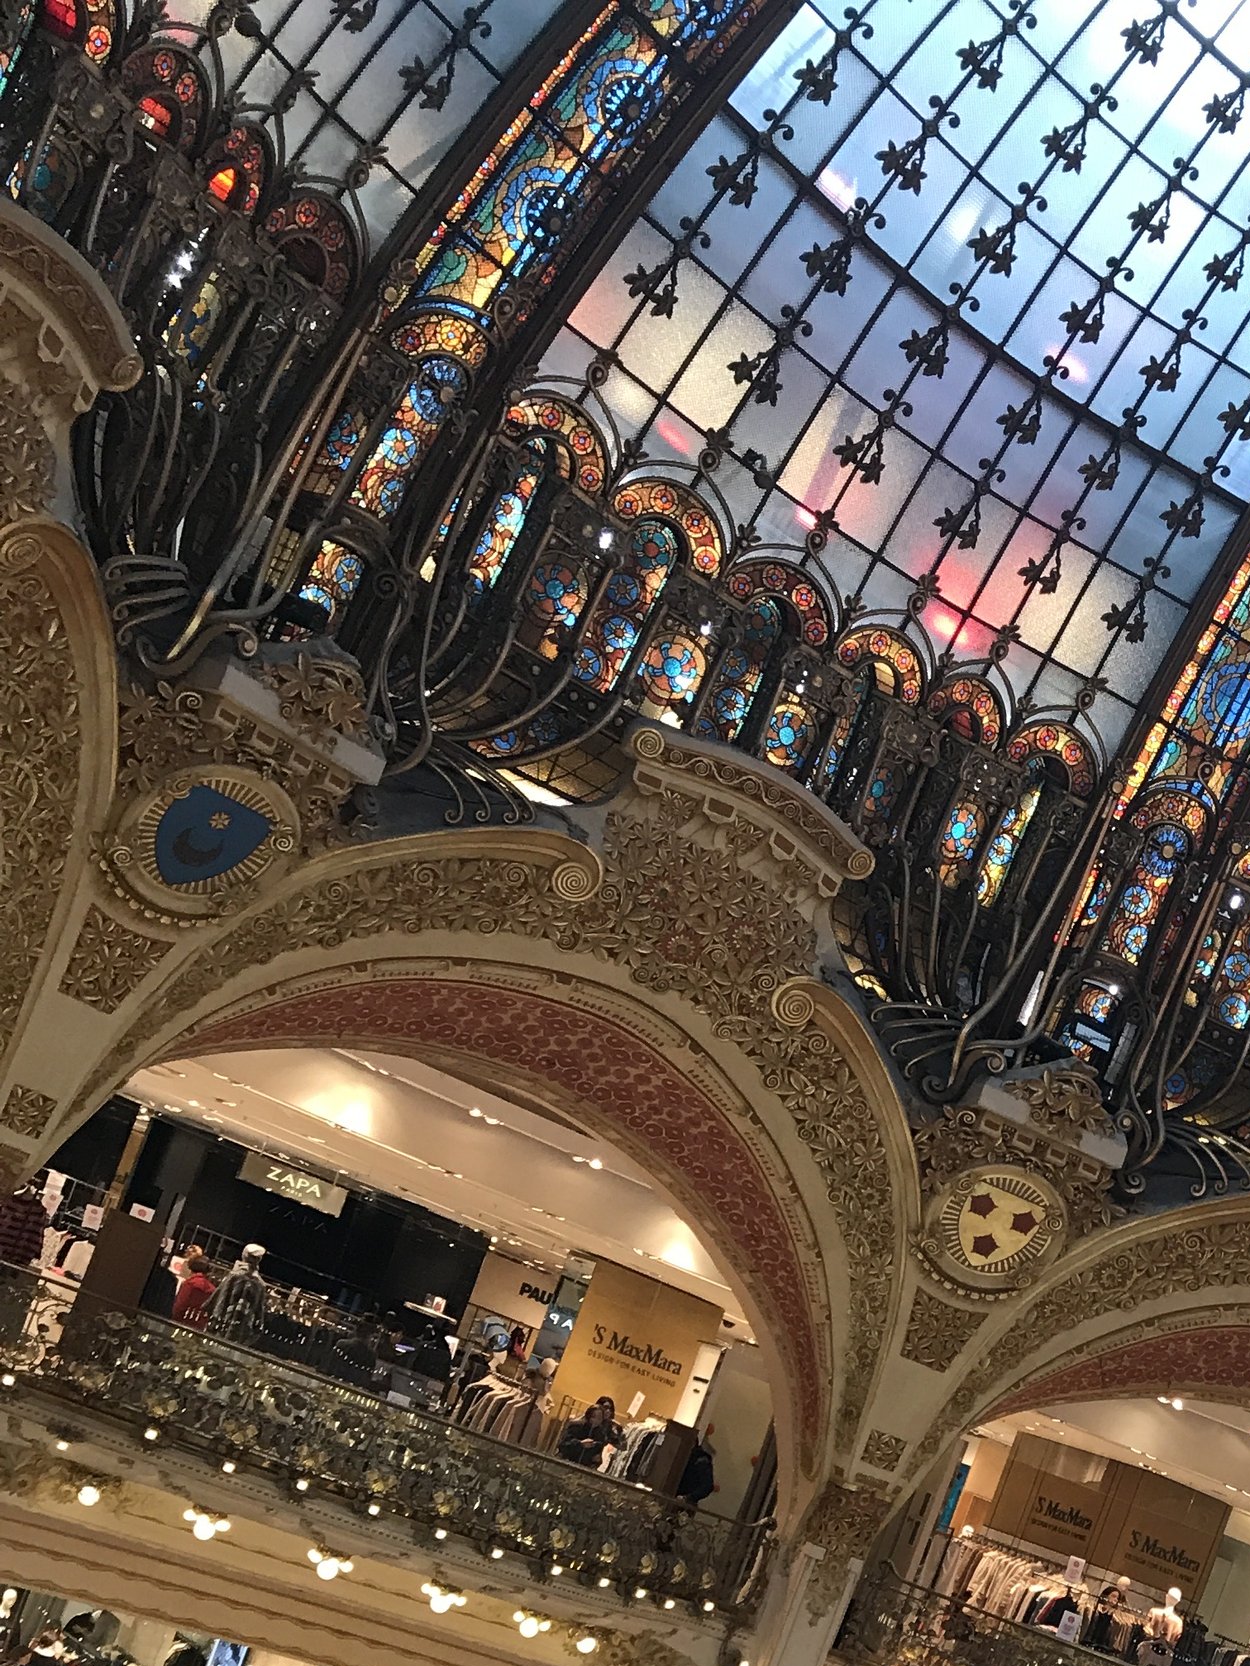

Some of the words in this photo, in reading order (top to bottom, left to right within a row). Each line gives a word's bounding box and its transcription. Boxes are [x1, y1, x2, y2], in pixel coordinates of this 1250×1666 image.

[266, 1166, 321, 1198] ZAPA
[608, 1331, 683, 1376] MaxMara
[1141, 1535, 1201, 1573] MaxMara
